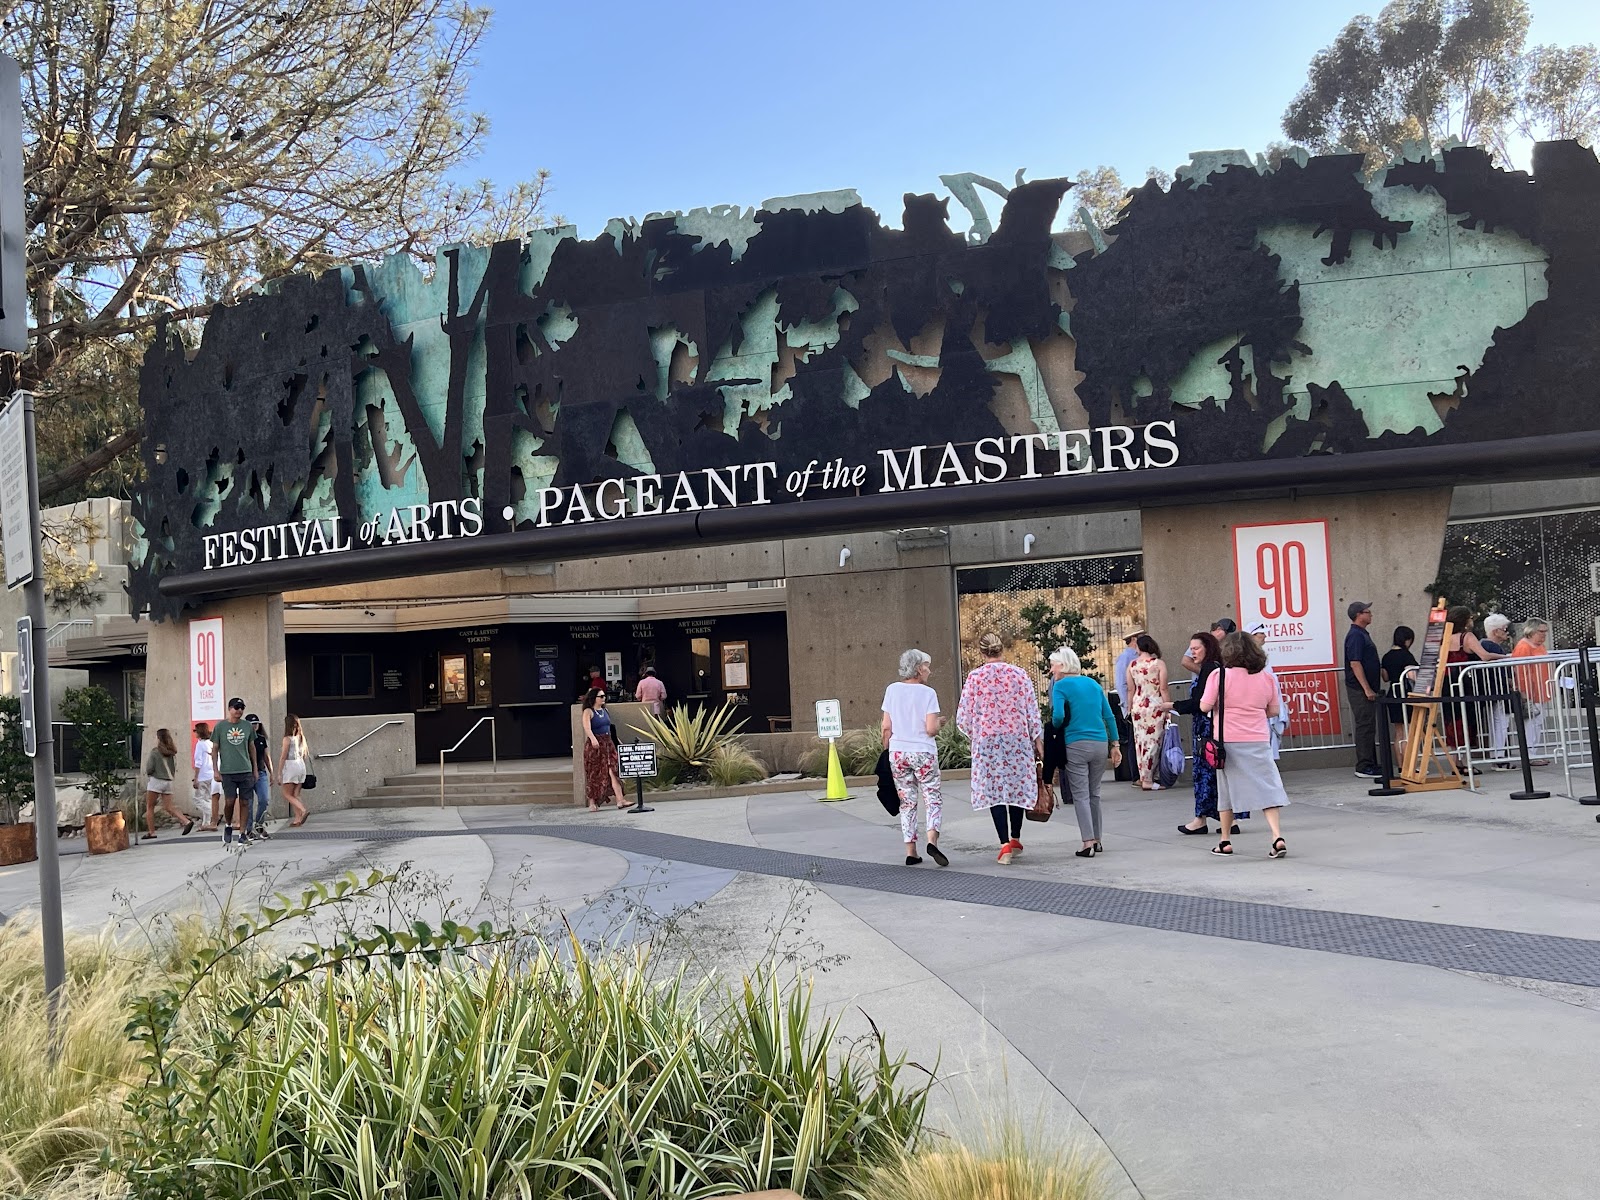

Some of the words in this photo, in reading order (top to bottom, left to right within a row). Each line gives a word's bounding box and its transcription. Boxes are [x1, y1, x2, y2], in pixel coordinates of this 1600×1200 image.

[202, 515, 351, 571] FESTIVAL
[359, 513, 383, 545] of
[382, 497, 484, 546] ARTS
[535, 461, 778, 528] PAGEANT
[785, 460, 819, 498] of
[822, 457, 867, 491] the
[876, 419, 1180, 493] MASTERS
[1256, 540, 1309, 619] 90
[569, 624, 600, 632] PAGEANT
[631, 623, 654, 631] WILL
[685, 626, 712, 635] TICKETS
[1265, 622, 1304, 637] YEARS
[632, 630, 655, 638] CALL
[467, 636, 491, 644] TICKETS
[133, 644, 148, 655] 650
[197, 631, 216, 687] 90
[1280, 681, 1306, 689] TIVAL
[1308, 680, 1321, 688] OF
[200, 689, 215, 700] YEARS
[1281, 691, 1330, 714] RTS
[825, 706, 831, 714] 5
